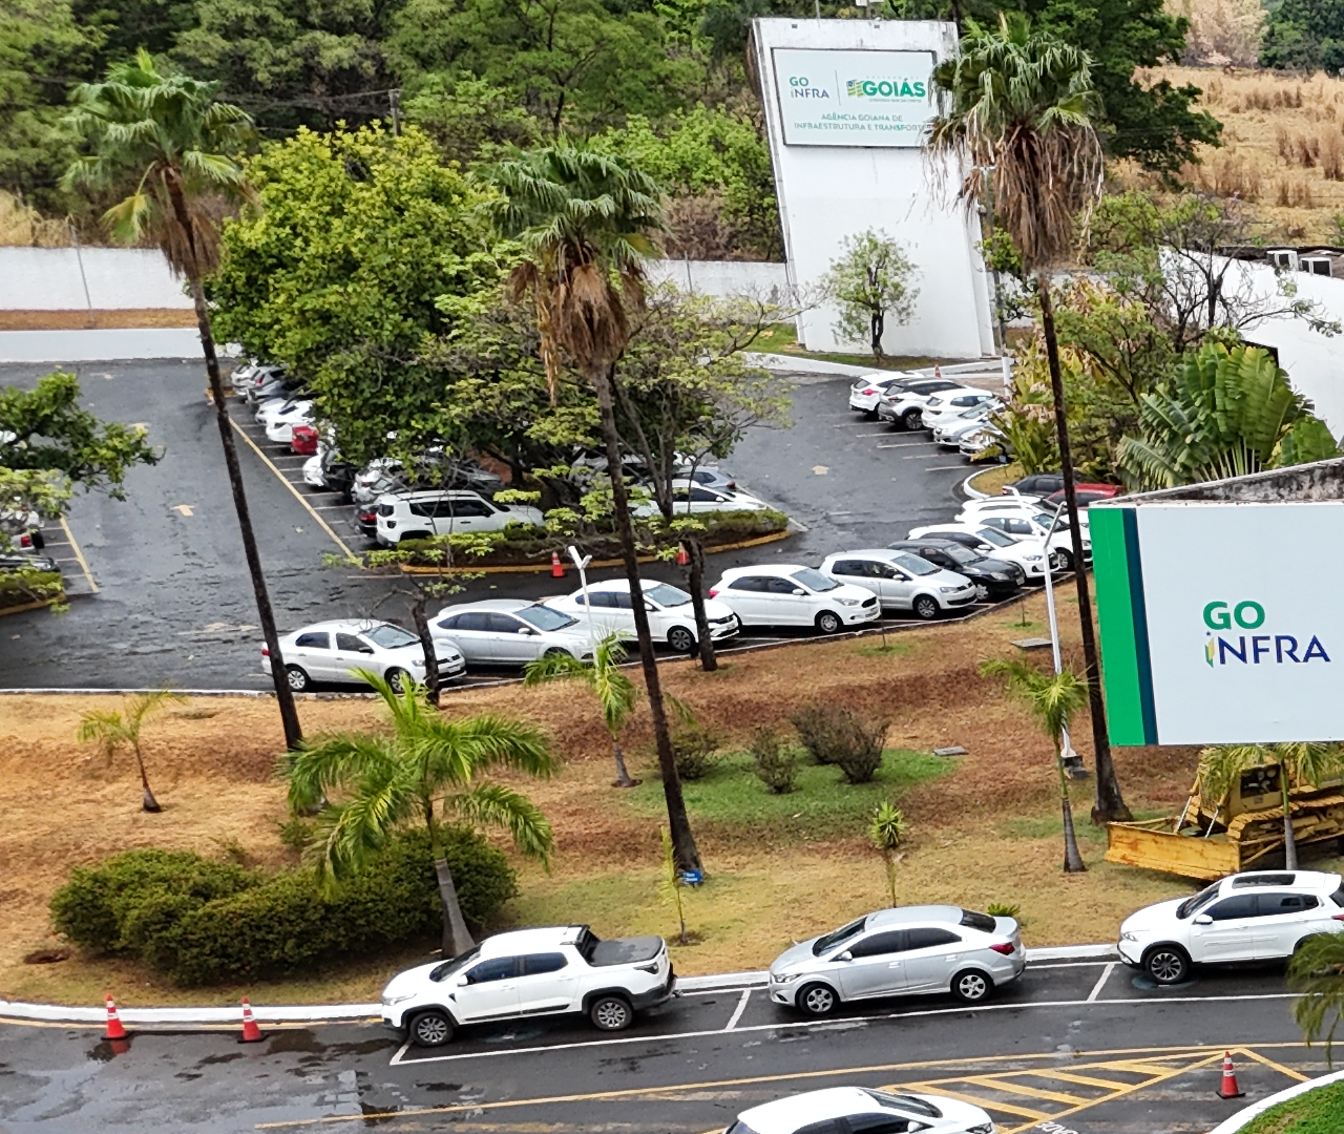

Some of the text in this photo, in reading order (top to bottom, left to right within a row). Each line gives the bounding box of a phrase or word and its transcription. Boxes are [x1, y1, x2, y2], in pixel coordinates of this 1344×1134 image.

[789, 76, 809, 87] GO
[862, 78, 926, 98] GOIÁS
[1203, 601, 1265, 630] GO
